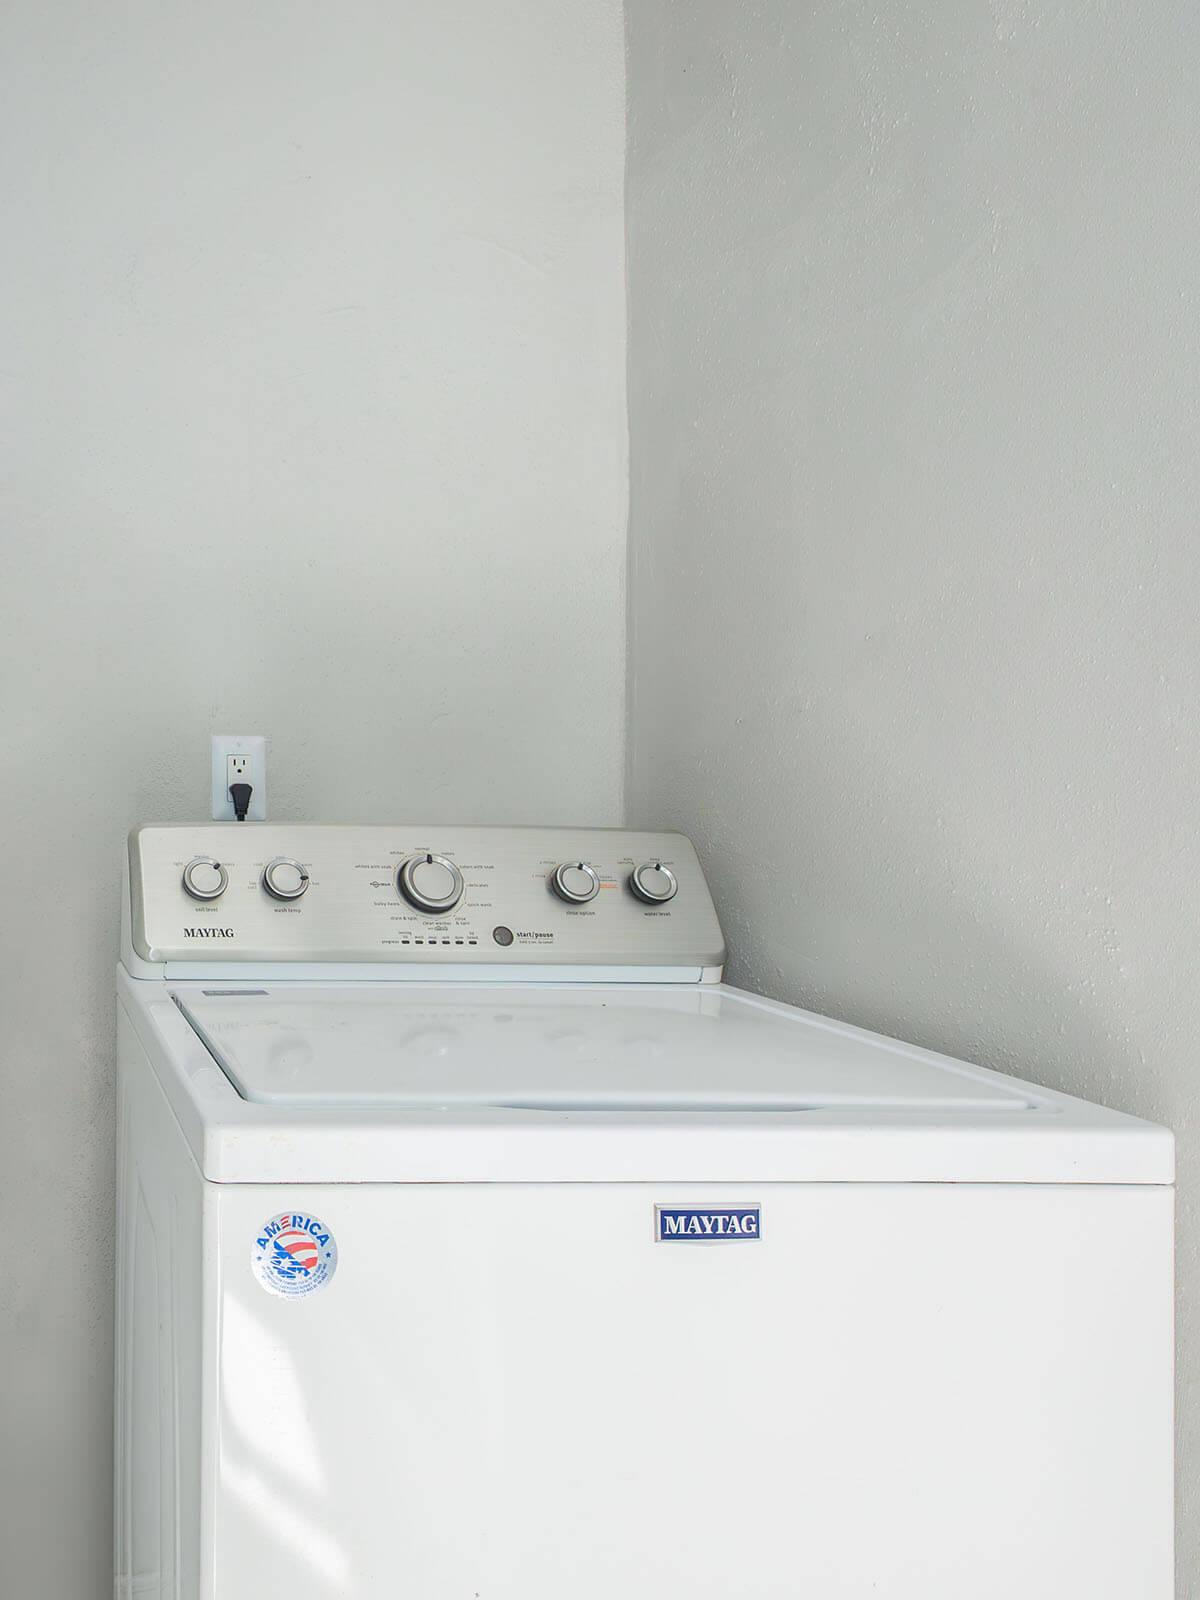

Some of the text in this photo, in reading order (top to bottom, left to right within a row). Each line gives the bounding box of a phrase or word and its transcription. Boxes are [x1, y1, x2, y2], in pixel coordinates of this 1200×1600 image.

[184, 928, 234, 938] MAYTAG
[256, 1215, 330, 1250] AMERICA
[664, 1215, 757, 1234] MAYTAG
